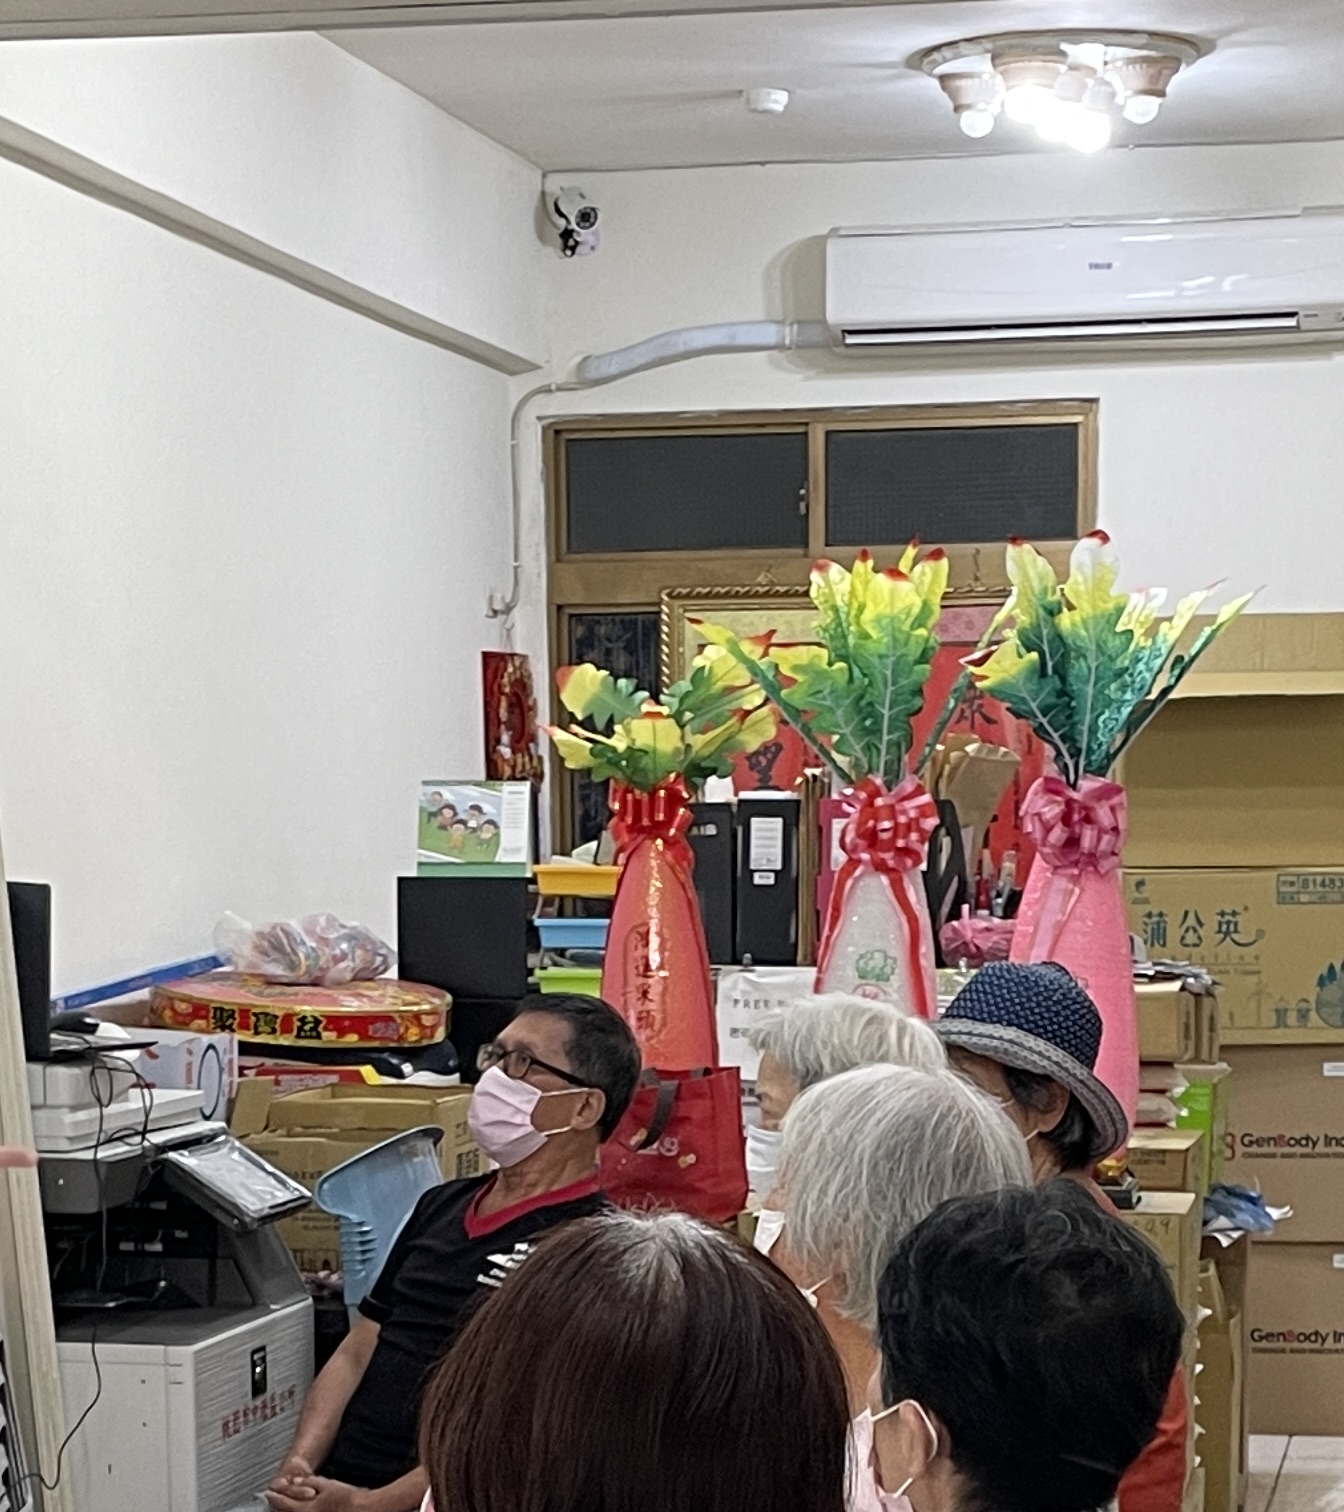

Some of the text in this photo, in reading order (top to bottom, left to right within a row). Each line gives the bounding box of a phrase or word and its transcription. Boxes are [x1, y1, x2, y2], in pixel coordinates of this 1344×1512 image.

[1141, 908, 1262, 949] 蒲公英
[1240, 1132, 1320, 1151] GenBody
[1250, 1328, 1330, 1347] GenBody
